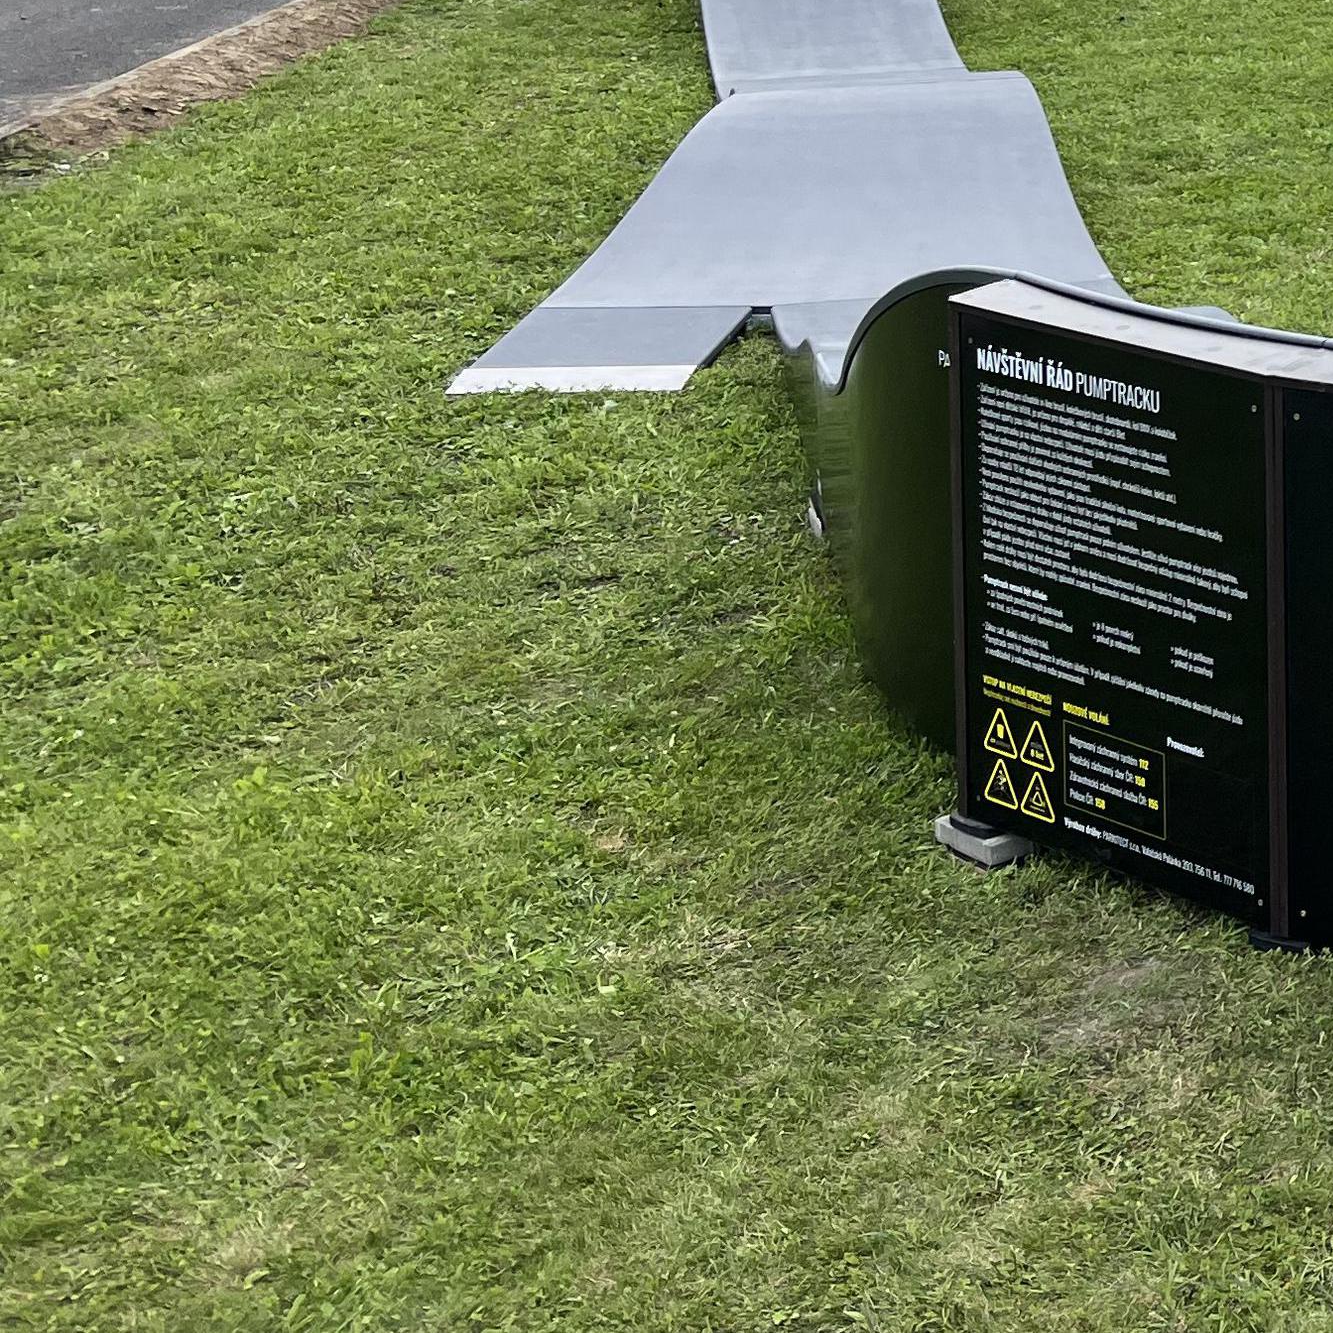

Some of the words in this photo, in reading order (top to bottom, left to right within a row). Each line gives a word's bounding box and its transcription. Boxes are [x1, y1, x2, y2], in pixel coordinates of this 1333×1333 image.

[977, 344, 1044, 385] NÁVŠTĚVNÍ
[1046, 359, 1073, 393] ŘÁD
[1075, 371, 1161, 414] PUMPTRACKU
